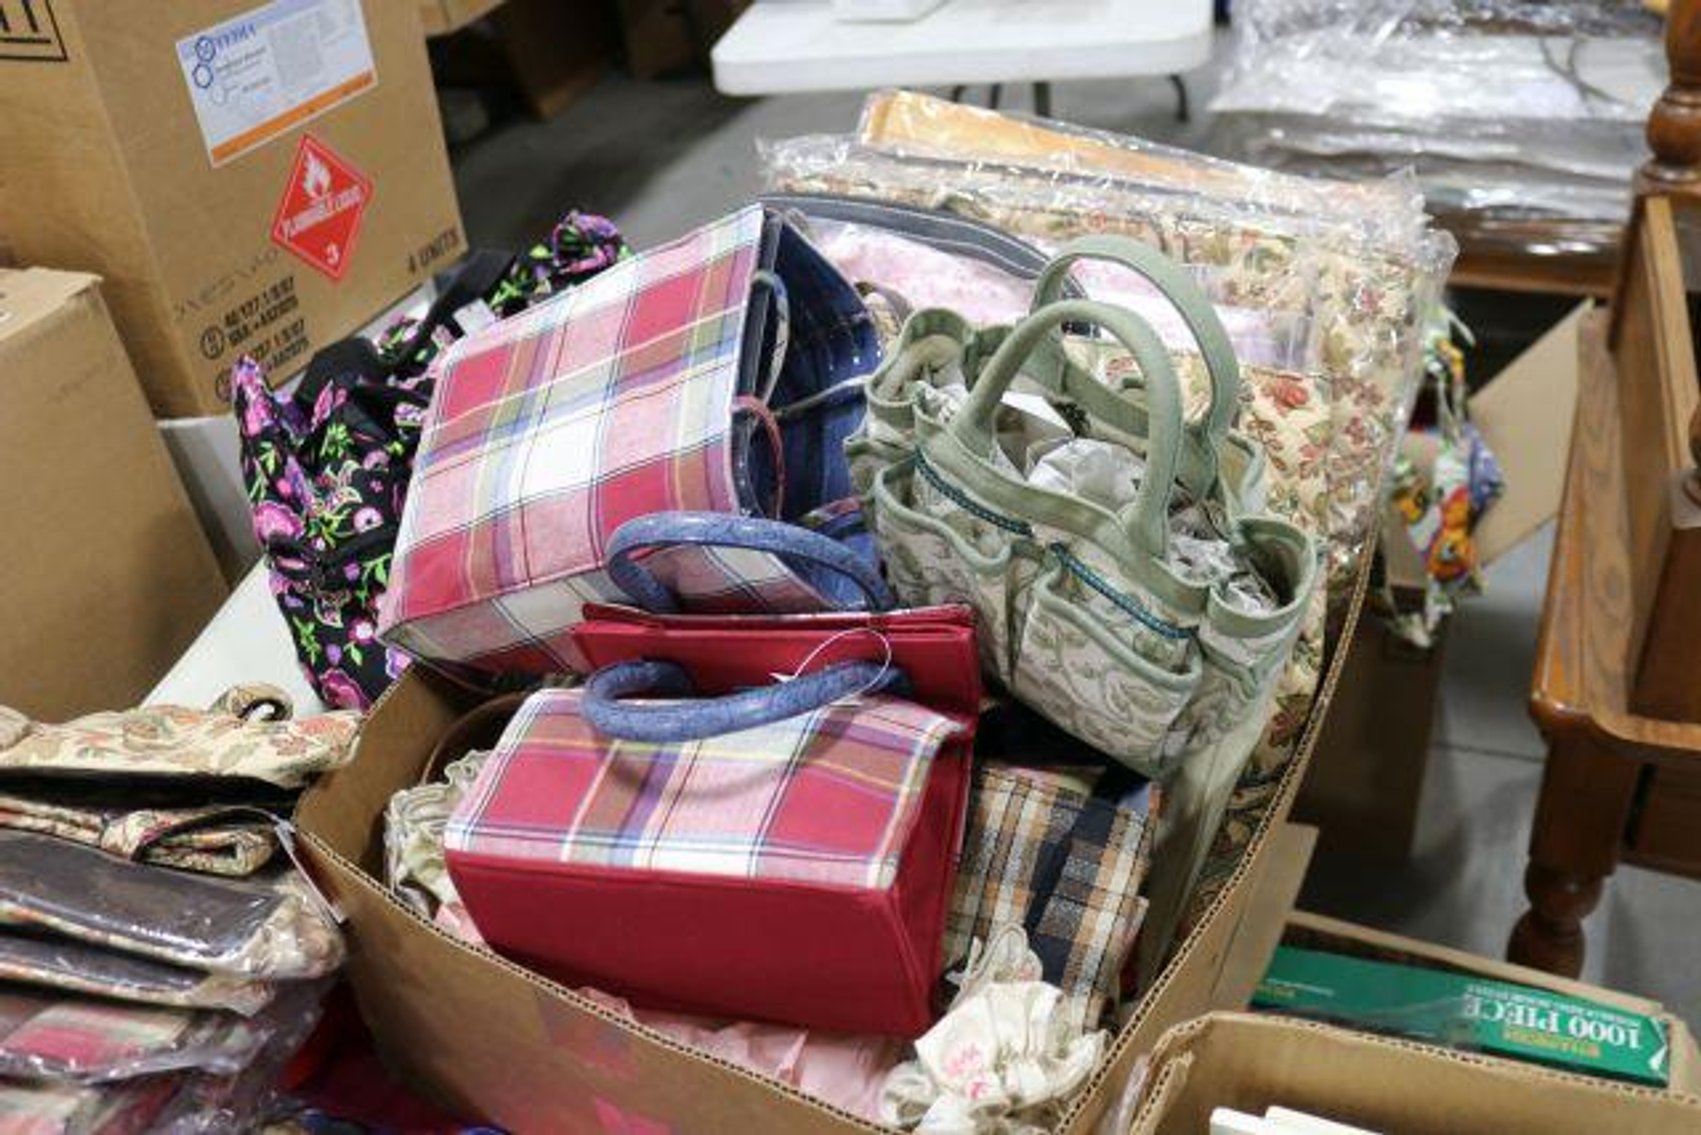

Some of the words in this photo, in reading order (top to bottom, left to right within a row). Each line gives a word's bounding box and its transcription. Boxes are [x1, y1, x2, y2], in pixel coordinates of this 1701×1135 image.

[326, 243, 340, 266] 3
[1463, 995, 1560, 1034] PIECE
[1568, 1013, 1642, 1049] 1000
